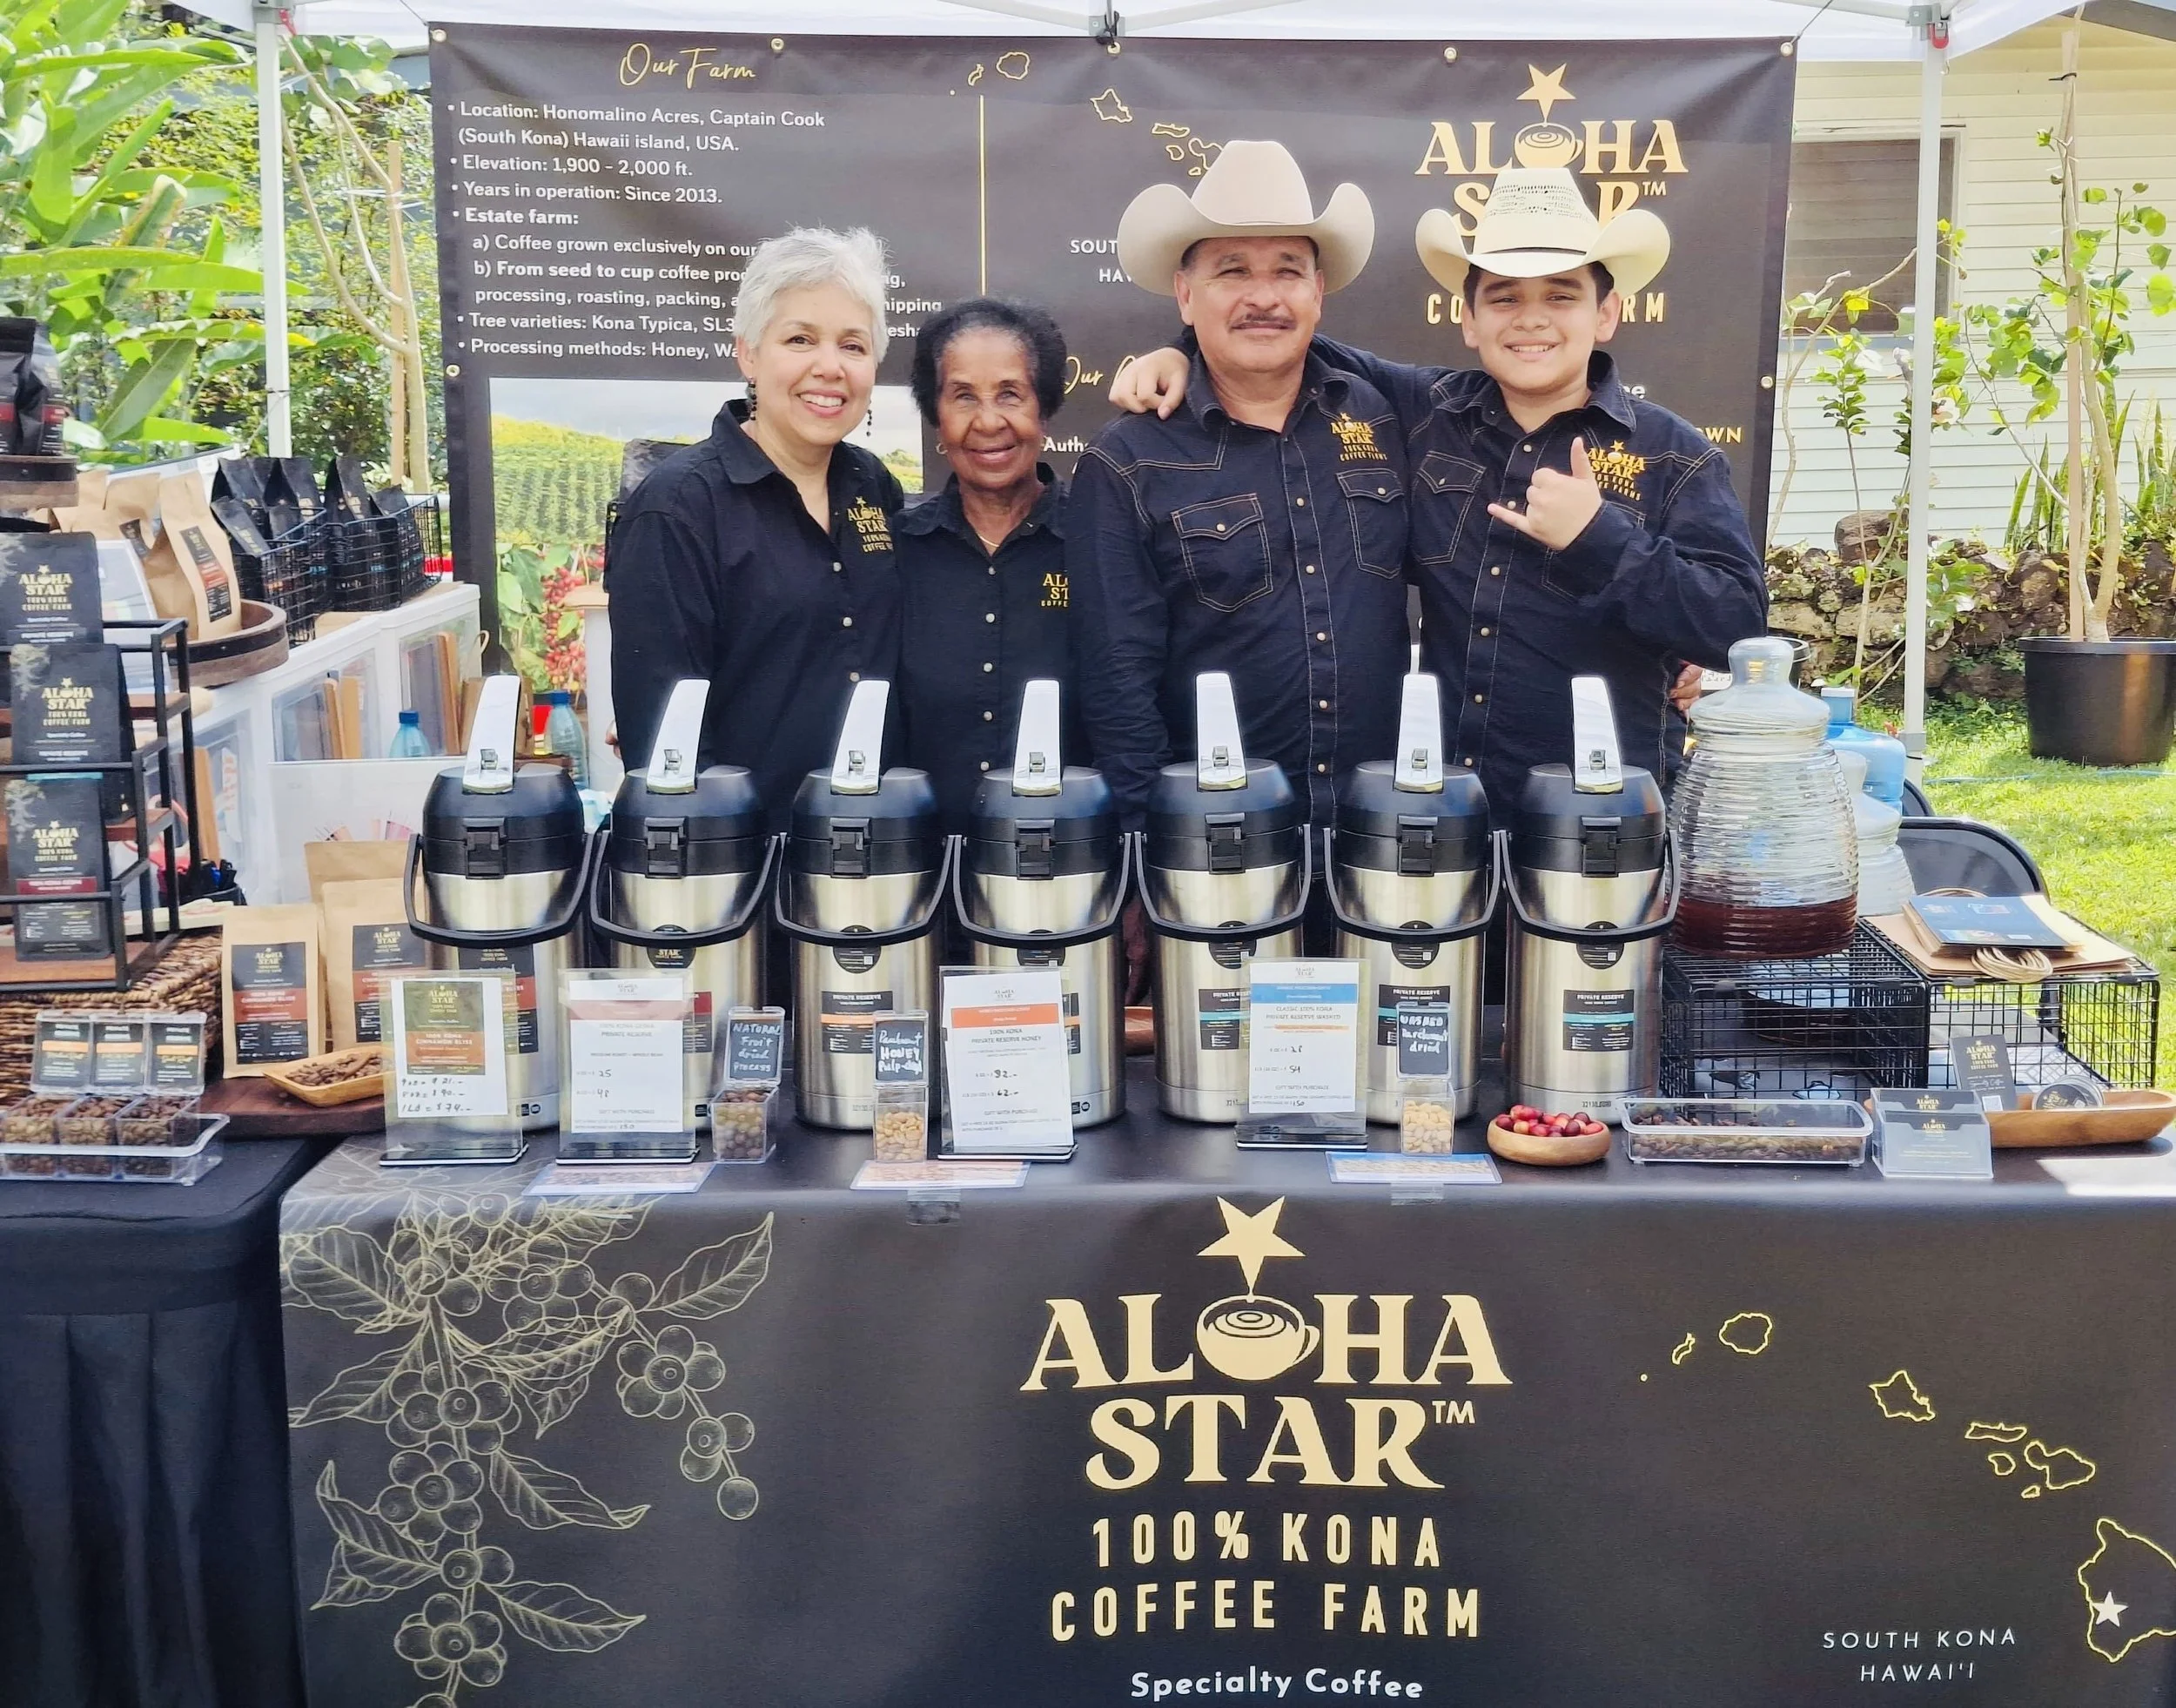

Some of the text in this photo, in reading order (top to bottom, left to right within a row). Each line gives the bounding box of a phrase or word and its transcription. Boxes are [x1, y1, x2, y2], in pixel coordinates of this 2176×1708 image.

[620, 43, 756, 89] Our Farm
[460, 100, 825, 128] Location: Honomalino Acres, Captain Cook
[458, 127, 740, 152] (South Kona) Hawaii island, USA.
[1414, 119, 1689, 175] ALOHA
[463, 154, 548, 171] Elevation:
[553, 157, 600, 176] 1,900
[618, 159, 669, 177] 2,000
[674, 161, 693, 177] ft.
[464, 180, 723, 205] Years in operation: Since 2013.
[465, 207, 580, 225] Estate farm:
[473, 235, 490, 252] a)
[494, 234, 553, 251] Coffee
[556, 239, 609, 254] grown
[613, 239, 702, 258] exclusively
[705, 245, 726, 256] on
[1070, 239, 1118, 255] SOUT
[474, 260, 710, 283] b) From seed to cup coffee
[475, 287, 571, 306] processing,
[576, 290, 650, 307] roasting,
[655, 291, 727, 309] packing,
[468, 312, 507, 328] Tree
[510, 313, 587, 329] varieties:
[592, 315, 635, 330] Kona
[639, 316, 698, 333] Typica,
[471, 339, 564, 358] Processing
[568, 341, 647, 357] methods:
[652, 342, 709, 360] Honey,
[1331, 421, 1374, 434] ALOHA
[1588, 447, 1646, 471] ALOHA
[846, 507, 886, 521] ALOHA
[856, 520, 890, 533] STAR
[18, 573, 73, 585] ALOHA
[25, 583, 69, 595] STAR
[41, 687, 95, 699] ALOHA
[47, 698, 88, 710] STAR
[31, 827, 80, 839] ALOHA
[1019, 1293, 1514, 1392] ALOHA
[1092, 1510, 1441, 1568] 100% KONA
[1051, 1579, 1479, 1643] COFFEE FARM
[1823, 1627, 2016, 1650] SOUTH KONA
[1859, 1662, 1975, 1683] HAWAI'I
[1131, 1665, 1424, 1703] Specialty Coffee
